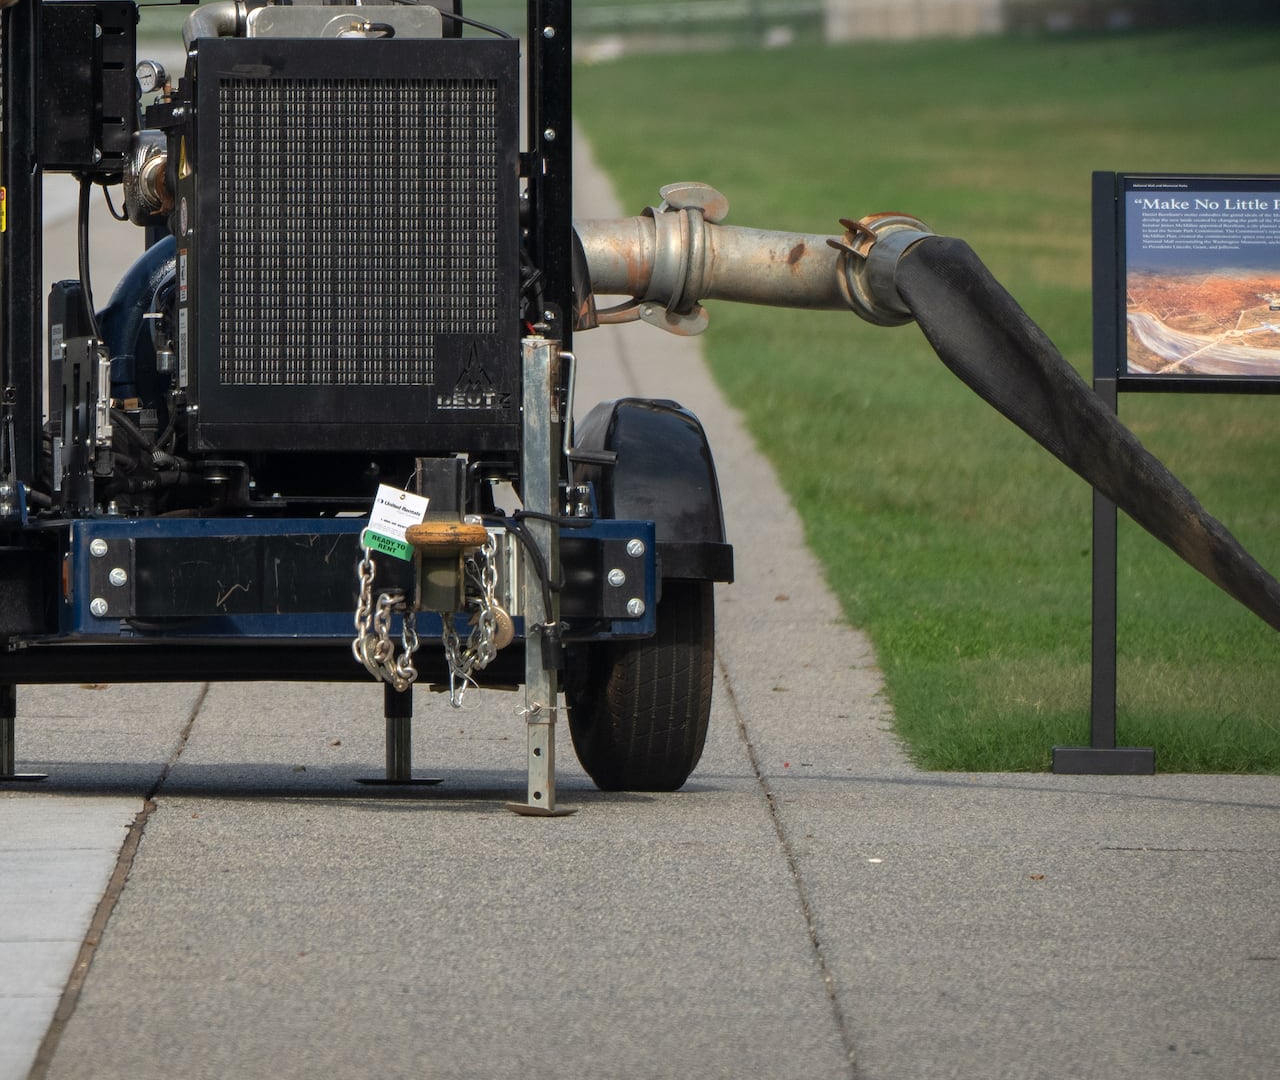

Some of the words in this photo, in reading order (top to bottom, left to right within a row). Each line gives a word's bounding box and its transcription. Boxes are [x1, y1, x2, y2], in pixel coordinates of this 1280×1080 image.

[1195, 199, 1220, 210] No
[1225, 199, 1269, 210] Little
[436, 392, 512, 410] DEUTZ
[372, 534, 396, 546] READY
[378, 542, 397, 552] RENT
